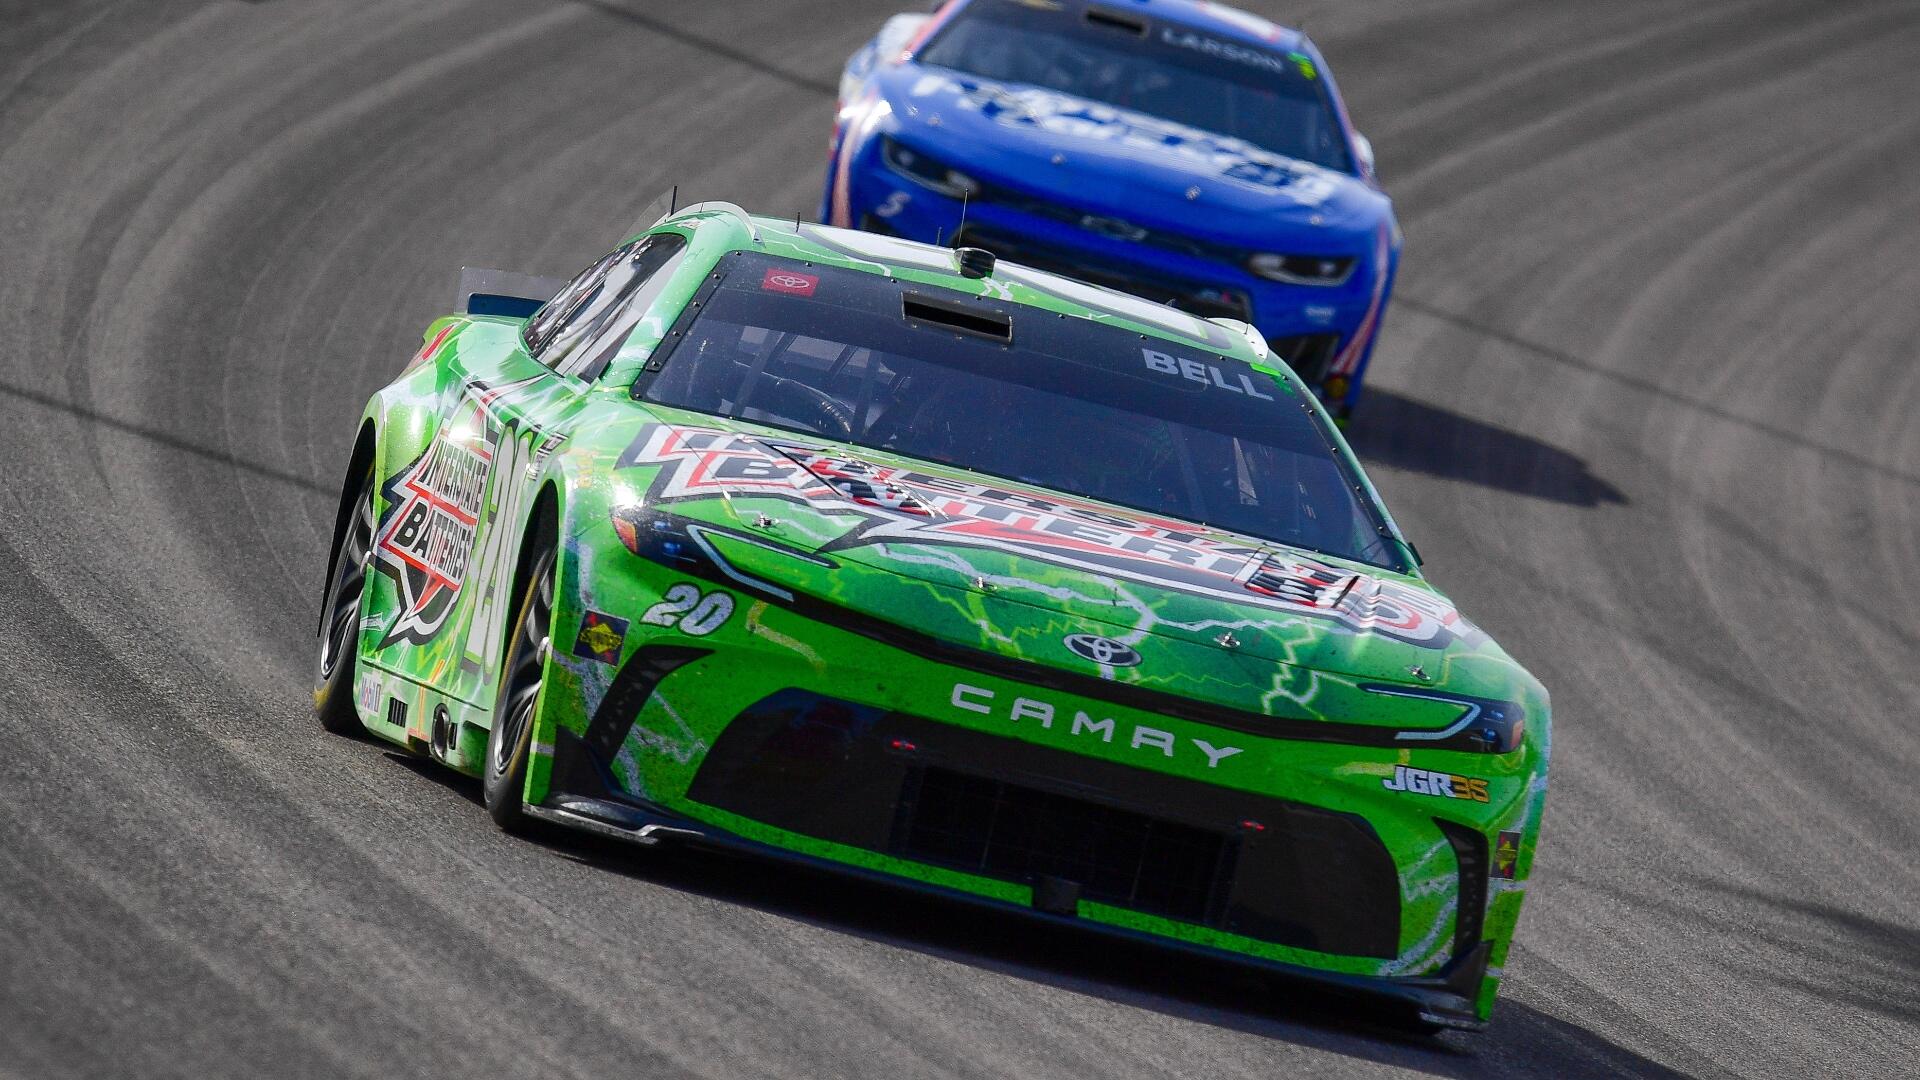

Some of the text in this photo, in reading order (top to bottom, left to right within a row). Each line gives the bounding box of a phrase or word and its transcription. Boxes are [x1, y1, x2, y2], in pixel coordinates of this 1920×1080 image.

[1161, 28, 1283, 72] LARSON
[1141, 348, 1274, 401] BELL
[415, 438, 488, 514] INTERSTATE
[394, 502, 472, 580] BATTERIES
[640, 582, 736, 636] 20
[951, 683, 1244, 768] CAMRY
